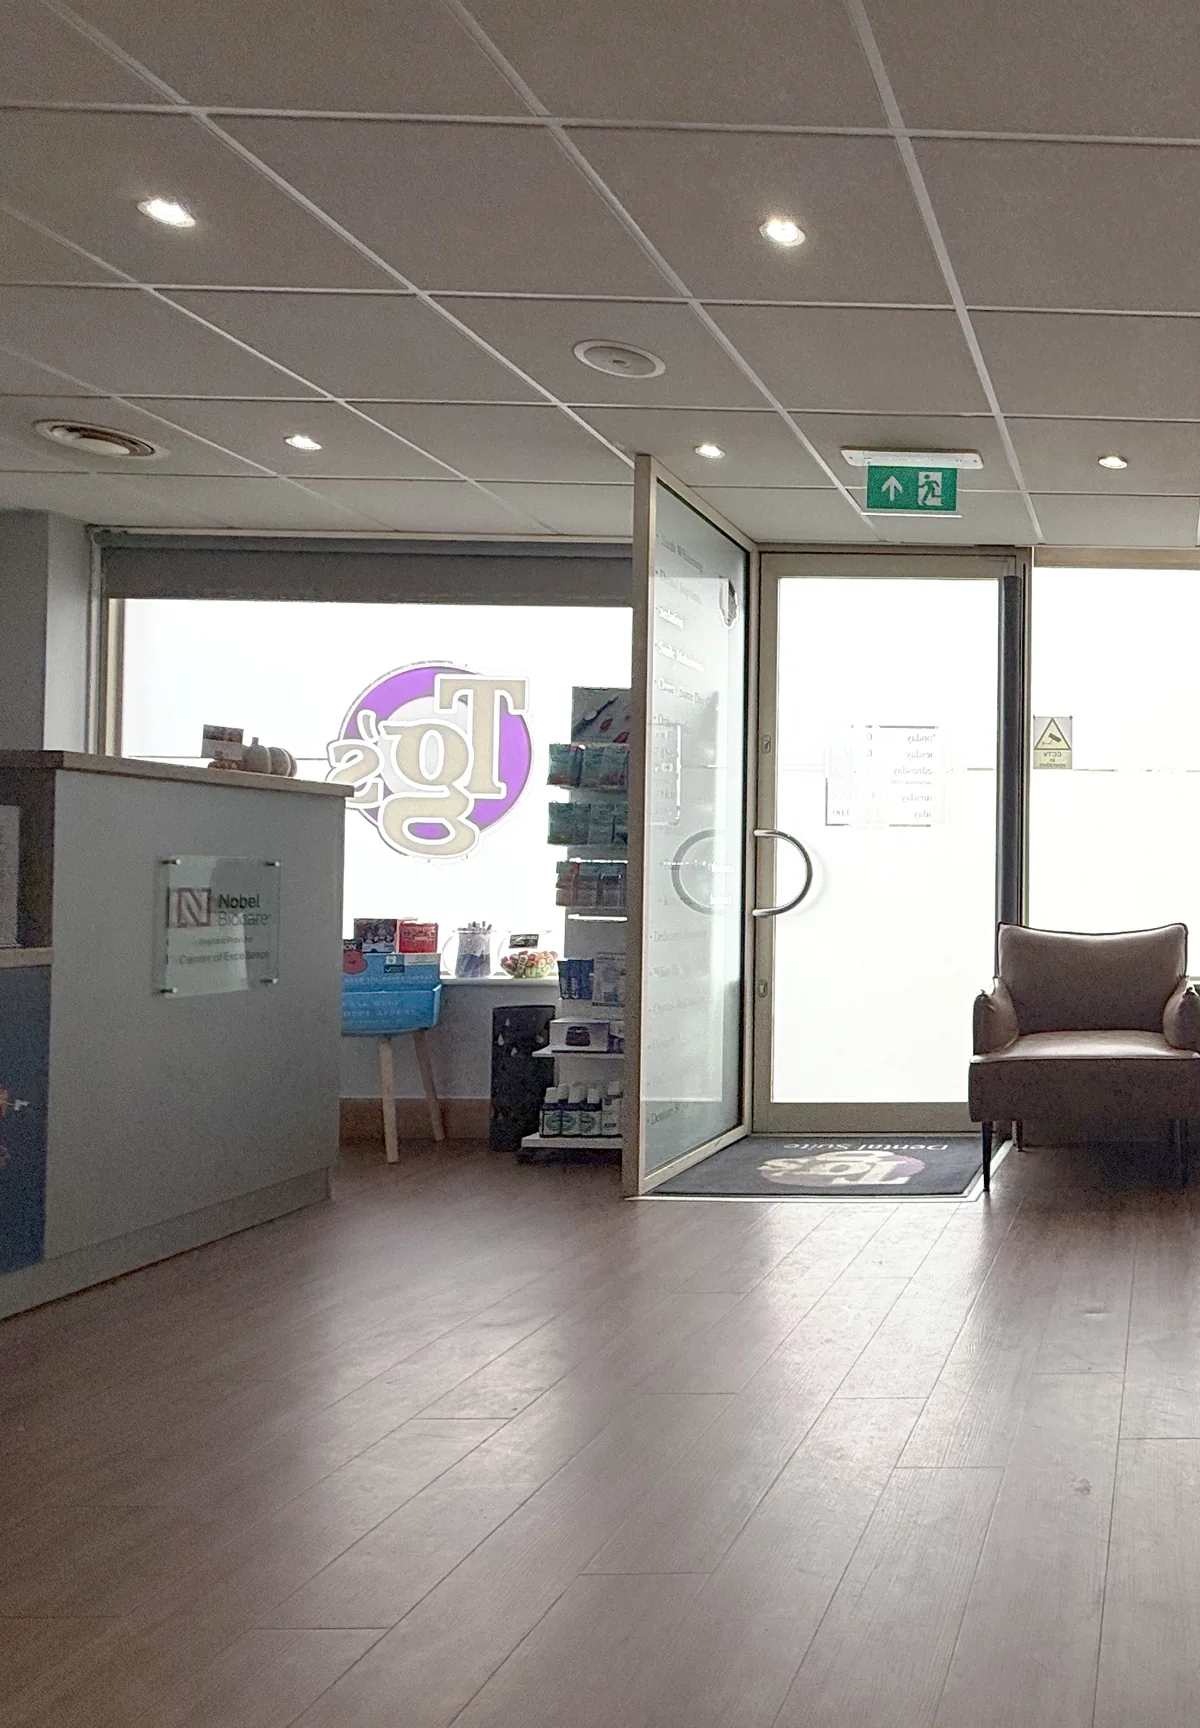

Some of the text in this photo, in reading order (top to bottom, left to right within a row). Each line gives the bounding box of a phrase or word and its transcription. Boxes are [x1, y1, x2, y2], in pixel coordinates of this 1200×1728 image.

[218, 893, 261, 909] Nobel
[217, 911, 269, 927] Biocare
[862, 1143, 949, 1151] Dental
